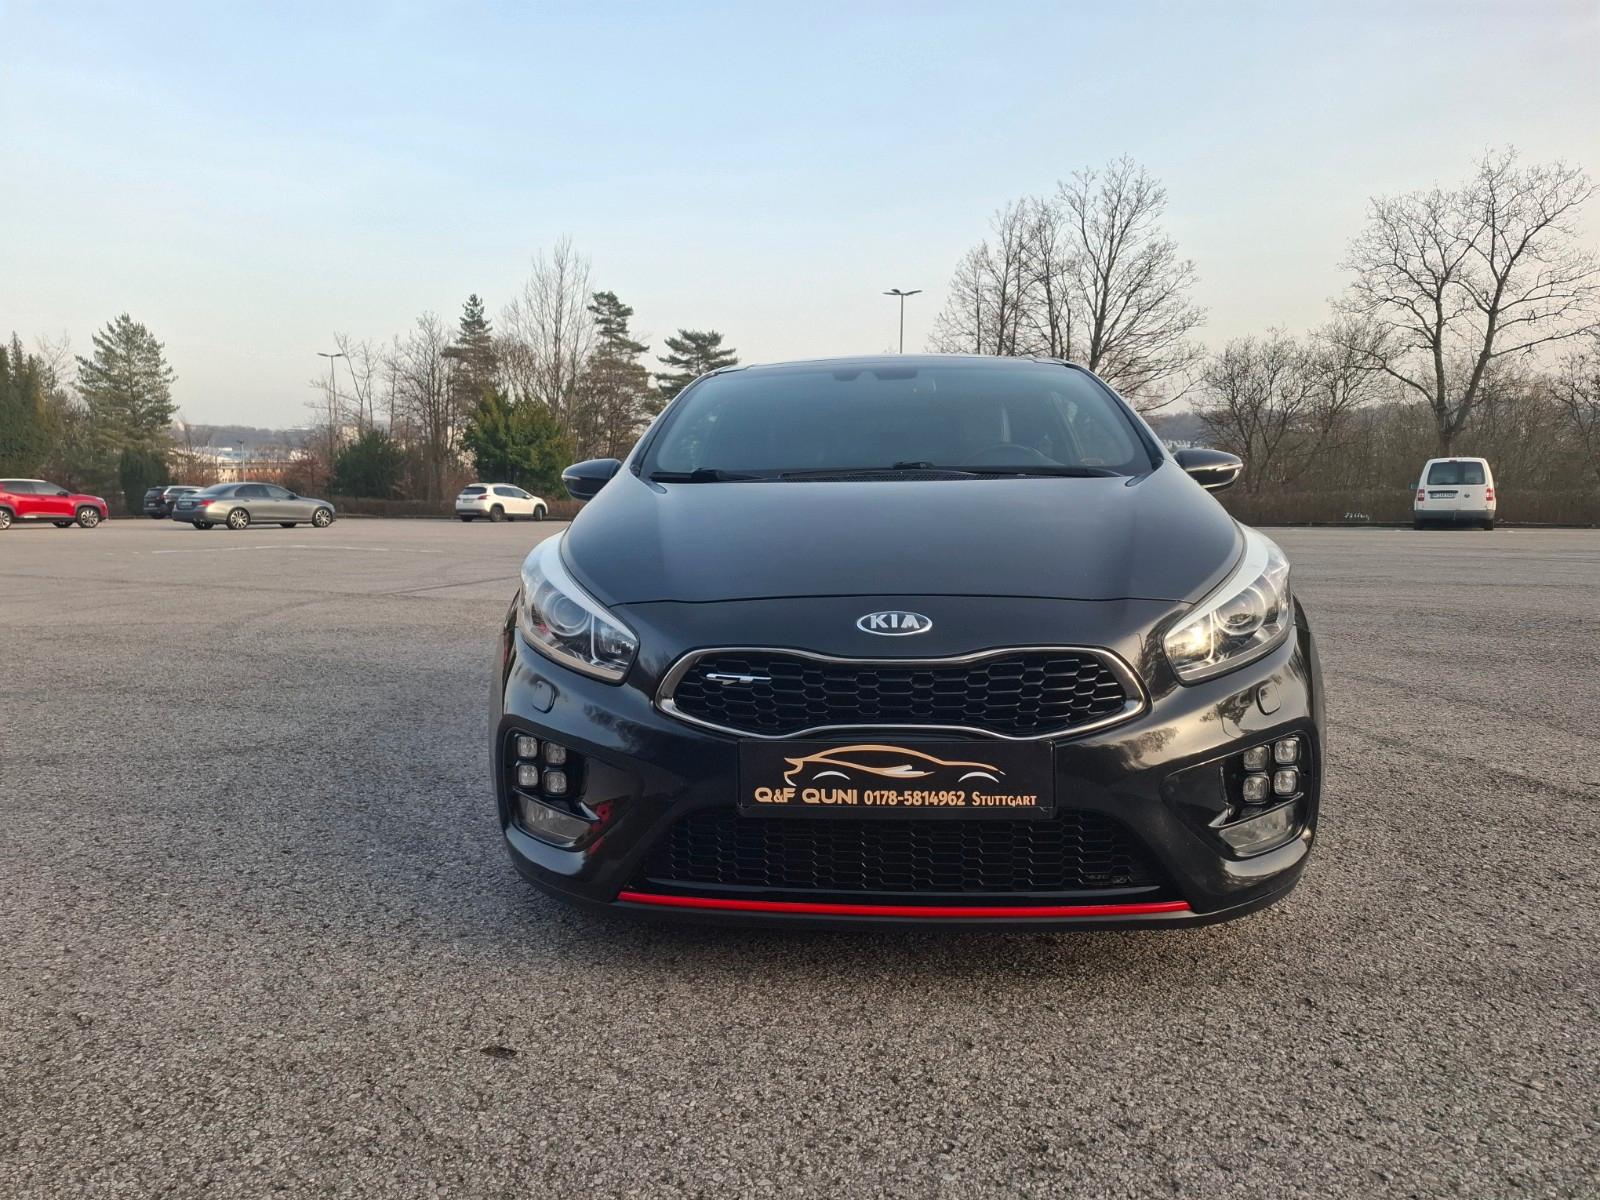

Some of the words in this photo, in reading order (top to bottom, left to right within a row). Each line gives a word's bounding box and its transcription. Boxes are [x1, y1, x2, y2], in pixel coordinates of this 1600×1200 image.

[869, 613, 921, 629] KIA
[754, 787, 796, 803] Q&F
[801, 788, 858, 805] QUNI
[863, 790, 966, 806] 0178-5814962
